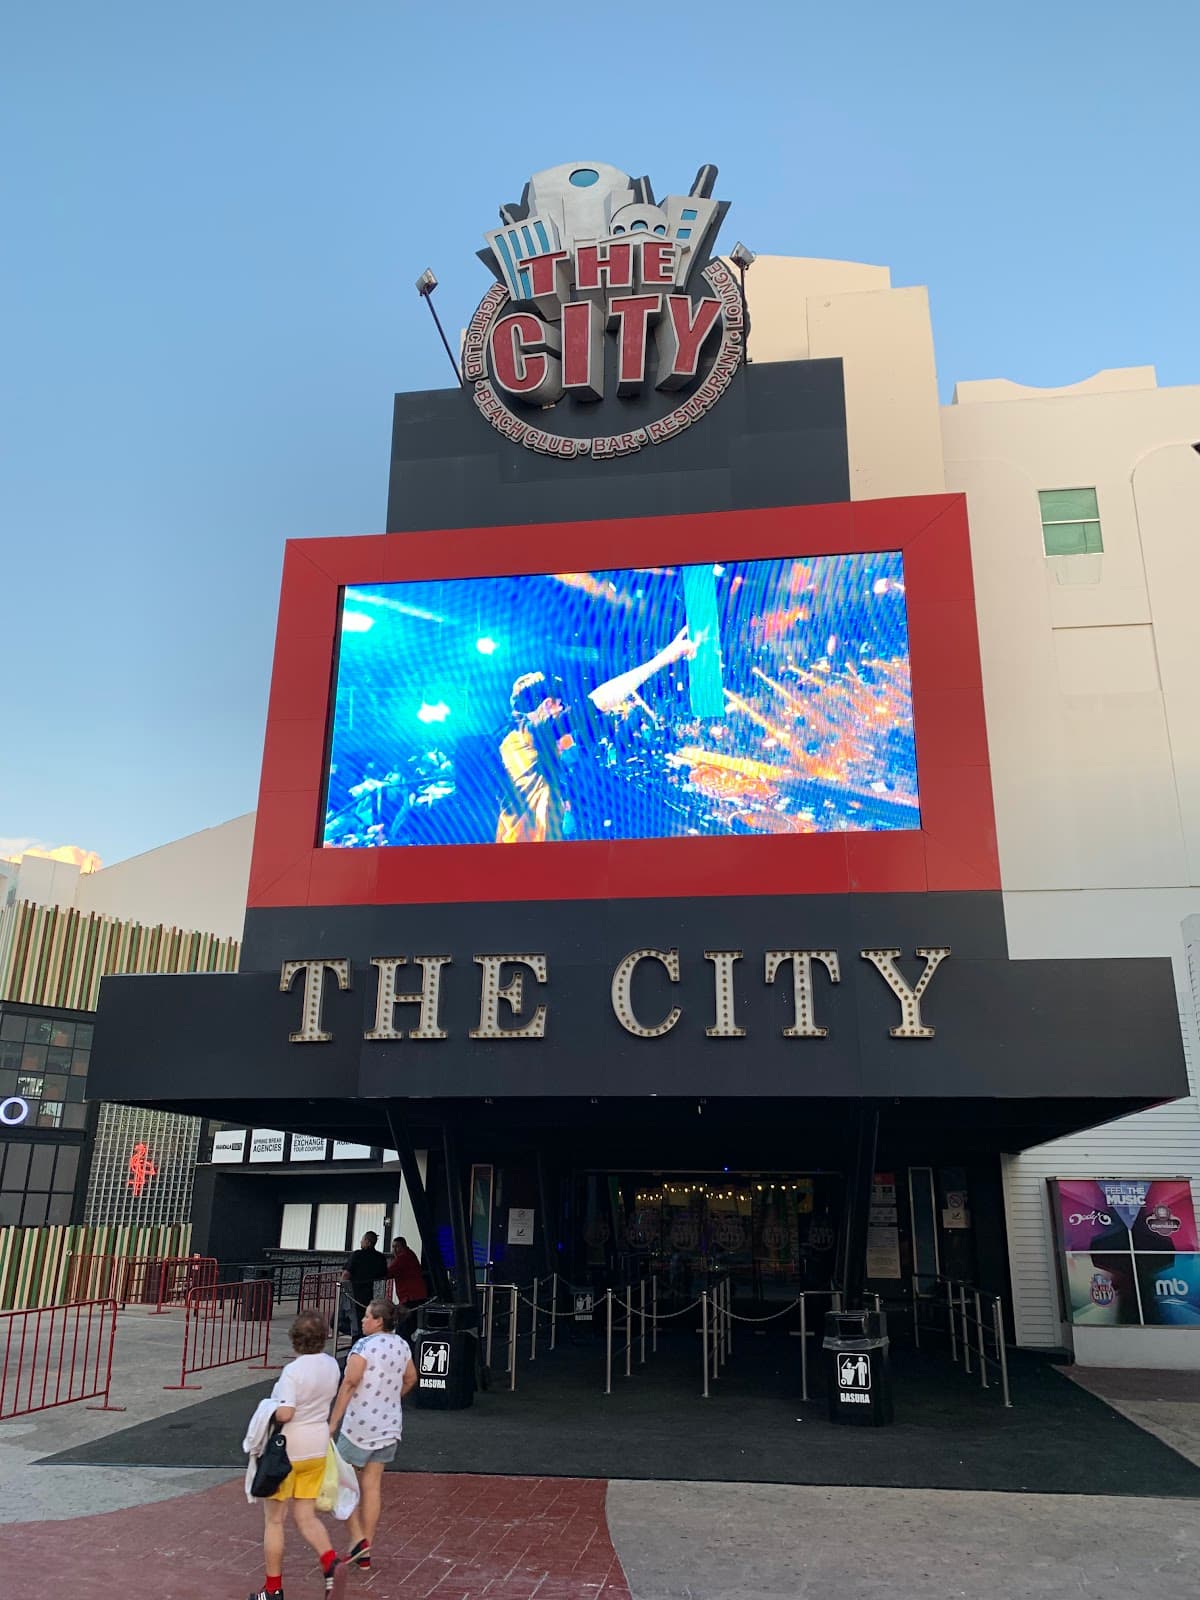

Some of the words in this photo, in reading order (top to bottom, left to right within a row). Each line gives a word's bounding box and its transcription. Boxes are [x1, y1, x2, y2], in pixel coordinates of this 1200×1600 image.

[516, 240, 677, 300] THE
[705, 260, 744, 334] LOUNGE
[490, 293, 723, 394] CITY
[649, 341, 743, 439] RESTAURANT
[476, 388, 524, 440] BEACH
[525, 428, 575, 454] CLUB
[593, 433, 635, 454] BAR
[280, 953, 547, 1042] THE
[611, 946, 951, 1038] CITY
[253, 1143, 282, 1153] AGENCIES
[293, 1138, 325, 1147] EXCHANGE
[1105, 1186, 1123, 1195] FEEL
[1128, 1187, 1145, 1195] THE
[1106, 1194, 1146, 1205] MUSIC
[1155, 1278, 1189, 1296] mb
[420, 1378, 446, 1389] BASURA
[840, 1392, 871, 1404] BASURA
